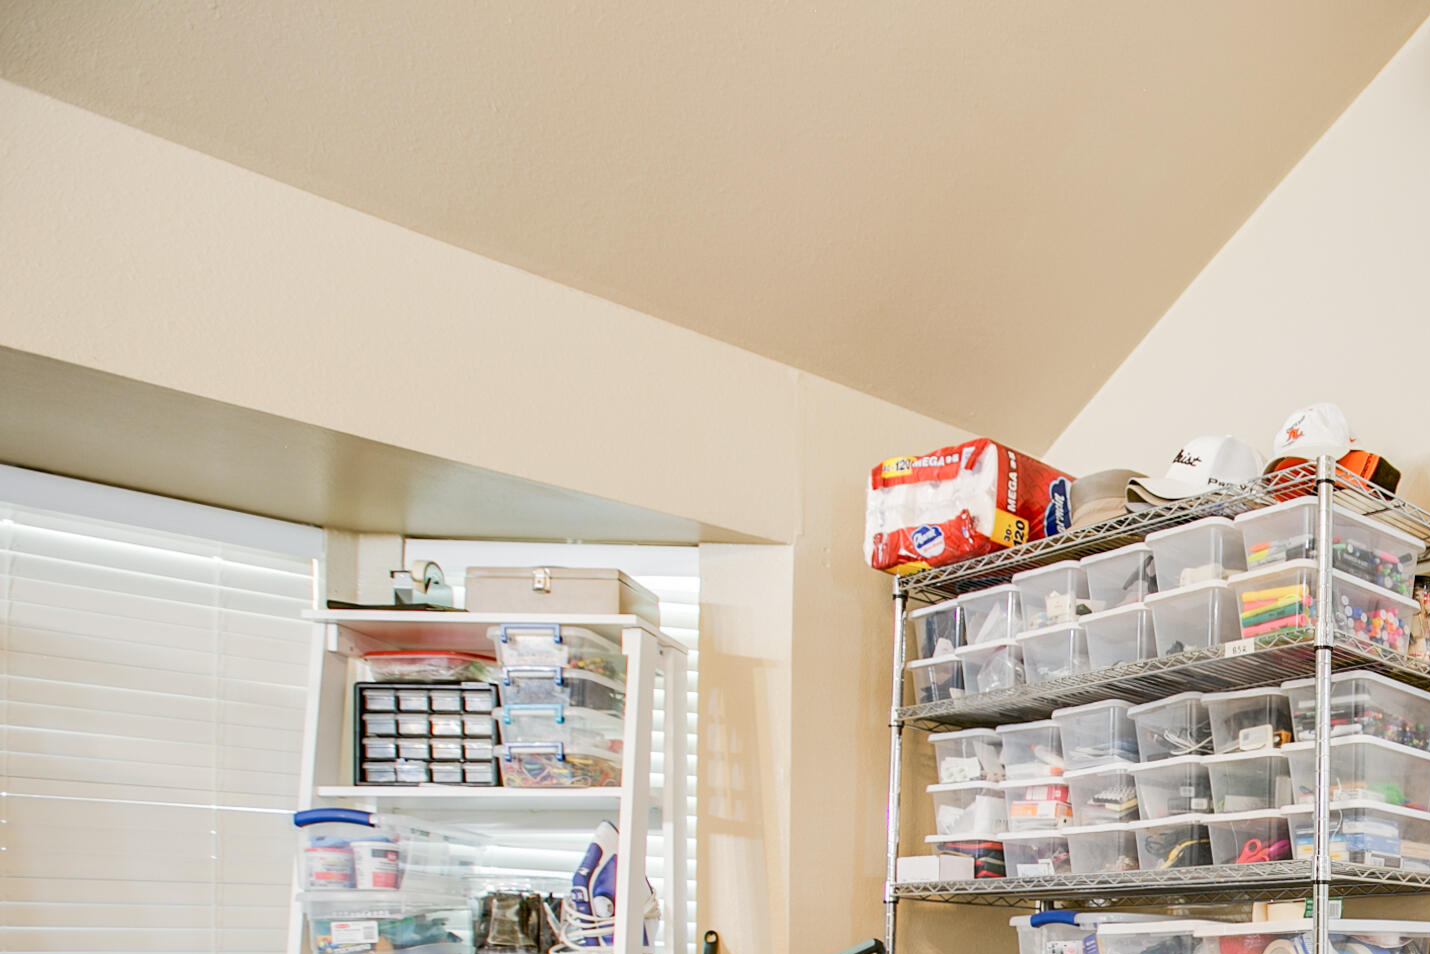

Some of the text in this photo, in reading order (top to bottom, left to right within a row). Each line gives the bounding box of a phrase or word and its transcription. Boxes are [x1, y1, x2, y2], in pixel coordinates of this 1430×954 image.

[912, 455, 945, 469] MEGA
[1006, 471, 1018, 513] MEGA
[1013, 519, 1026, 547] 120
